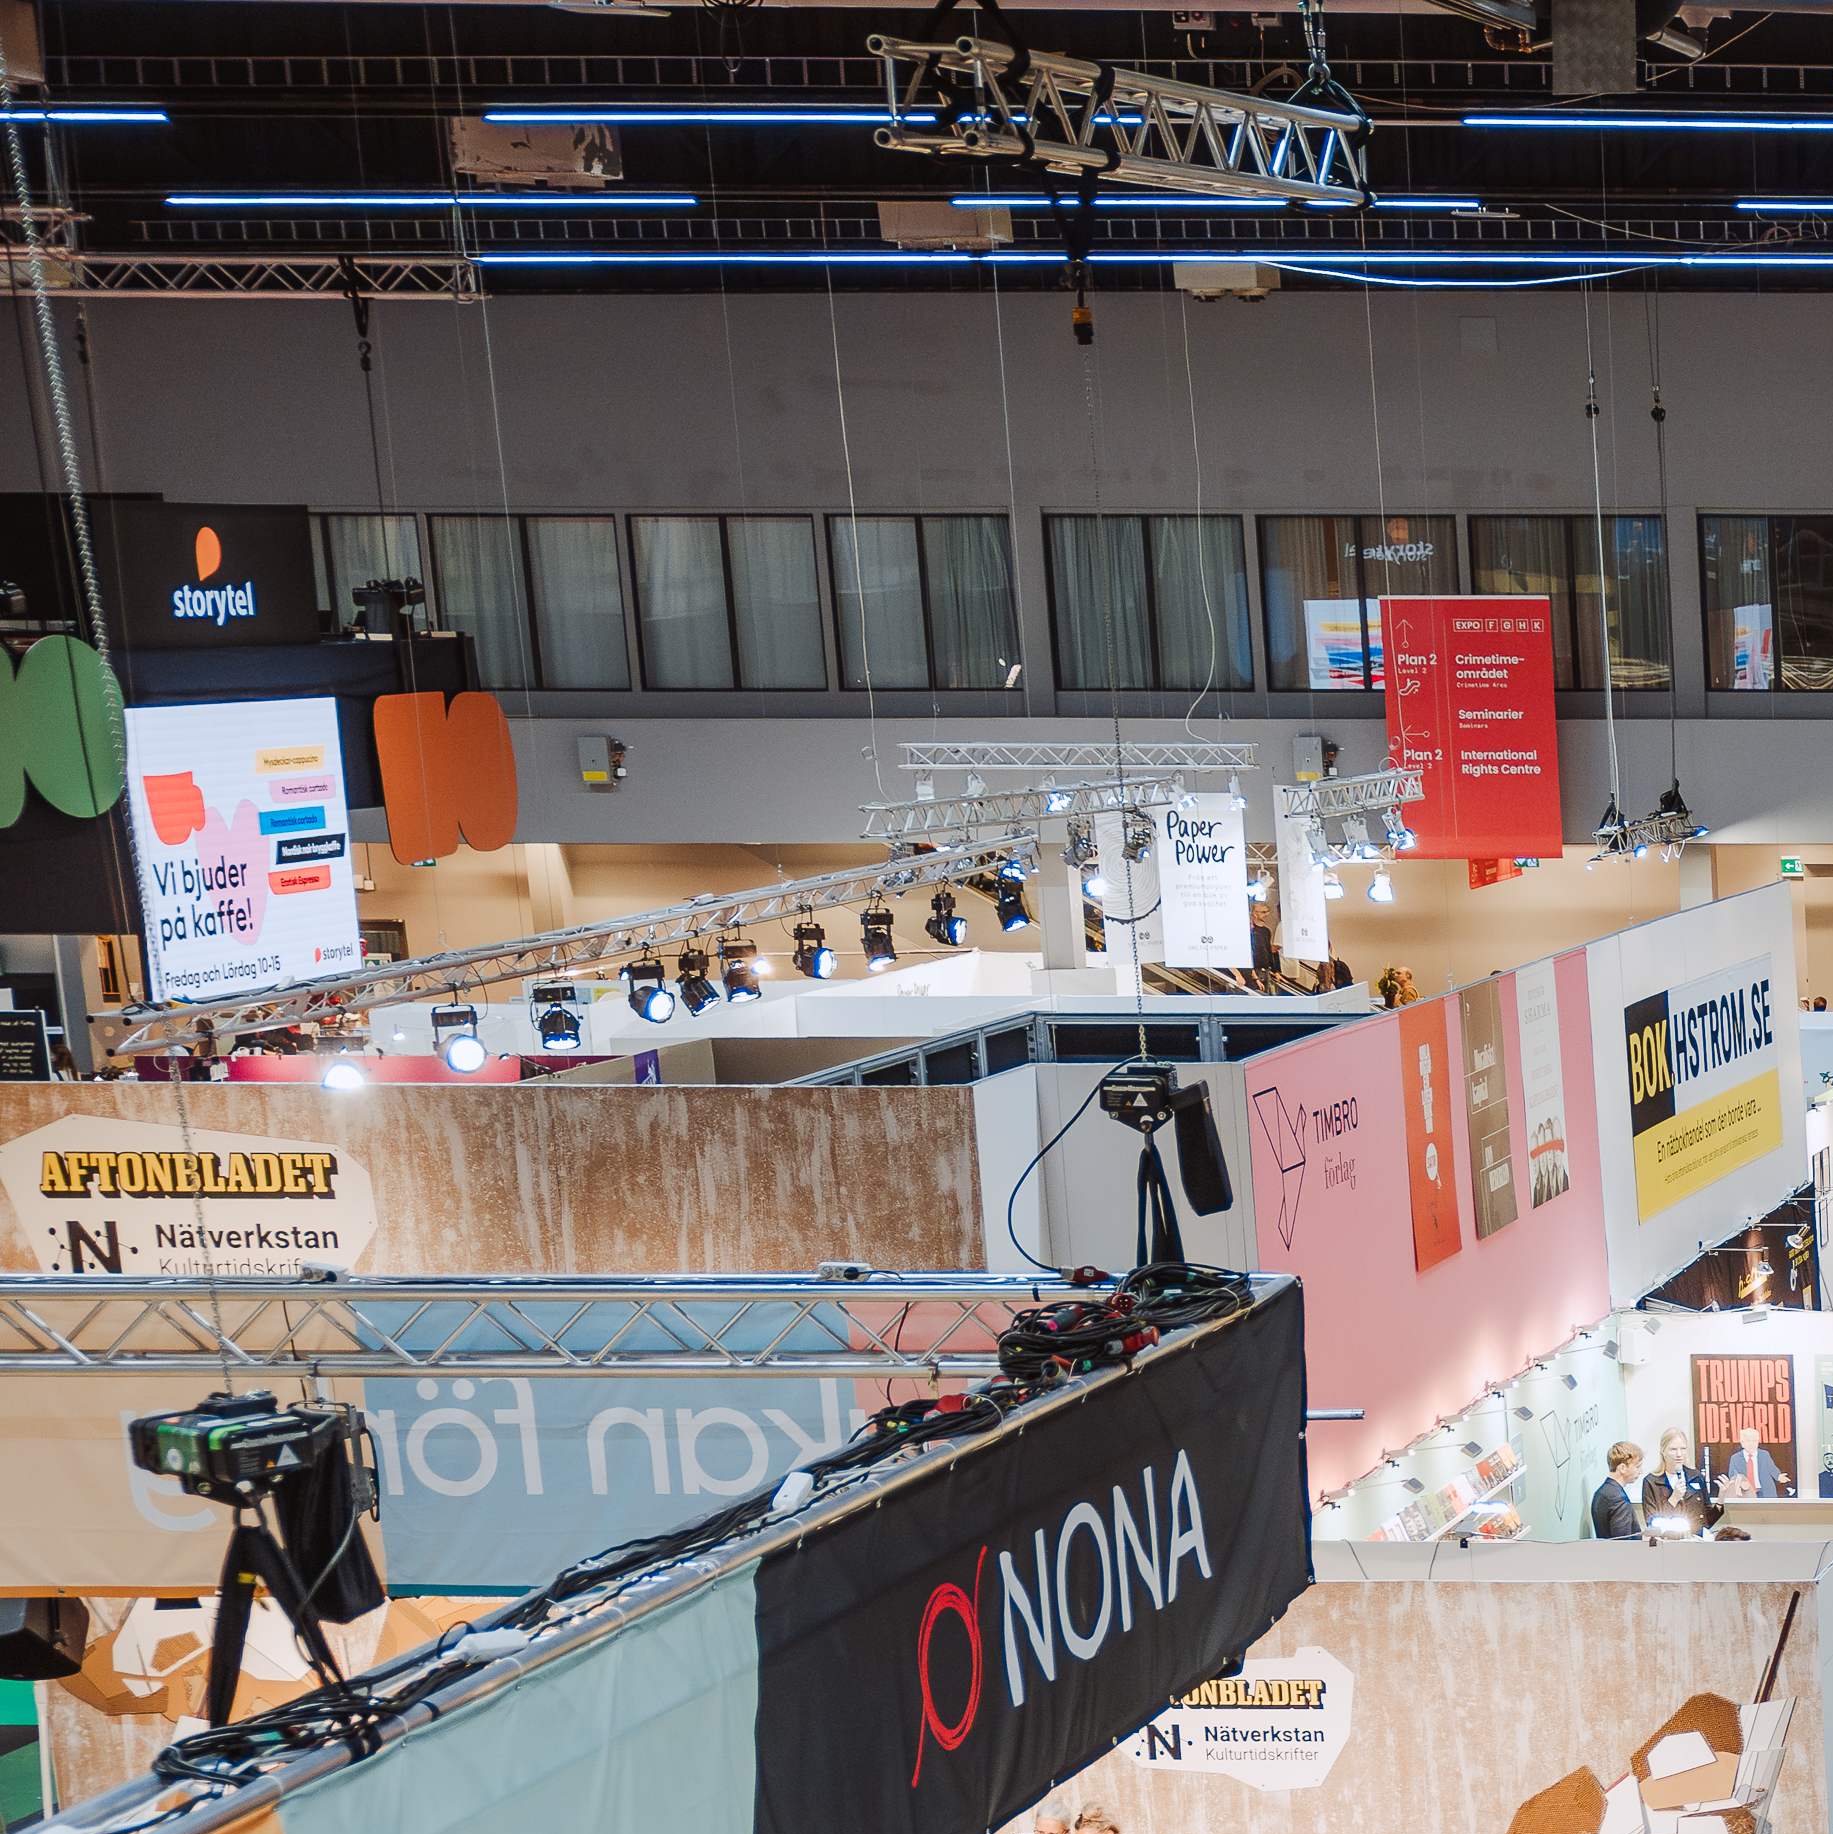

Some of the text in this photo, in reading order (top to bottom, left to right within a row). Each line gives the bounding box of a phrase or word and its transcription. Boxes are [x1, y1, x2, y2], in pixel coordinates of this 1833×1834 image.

[173, 581, 255, 626] storytel
[1456, 621, 1481, 630] EXPO
[1398, 655, 1438, 665] Plan 2
[1455, 655, 1525, 665] Crimetime-
[1456, 669, 1509, 680] området
[1458, 709, 1525, 720] Seminarier
[1403, 749, 1443, 761] Plan 2
[1461, 750, 1518, 761] International
[1462, 764, 1541, 777] Rights Centre
[1166, 810, 1222, 842] Paper
[1175, 840, 1234, 865] Power
[153, 856, 249, 902] Vi bjuder
[161, 898, 254, 951] på kaffe!
[322, 944, 353, 962] storytel
[165, 955, 281, 990] Fredag och Lördag 10-15
[1312, 1096, 1359, 1144] TIMBRO
[1657, 1141, 1666, 1162] En
[1666, 1121, 1704, 1156] nätbokhandel
[1705, 1119, 1716, 1138] som
[1717, 1110, 1727, 1133] den
[1727, 1103, 1744, 1127] borde
[1744, 1099, 1757, 1117] vara
[41, 1152, 339, 1200] AFTONBLADET
[1325, 1152, 1356, 1190] förlag
[155, 1223, 339, 1249] Nätverkstan
[1693, 1360, 1791, 1403] TRUMPS
[1697, 1400, 1792, 1445] IDÉVÄRLD
[998, 1448, 1212, 1708] NONA
[1203, 1726, 1324, 1742] Nätverkstan
[1204, 1748, 1319, 1762] Kulturtidskrifter
